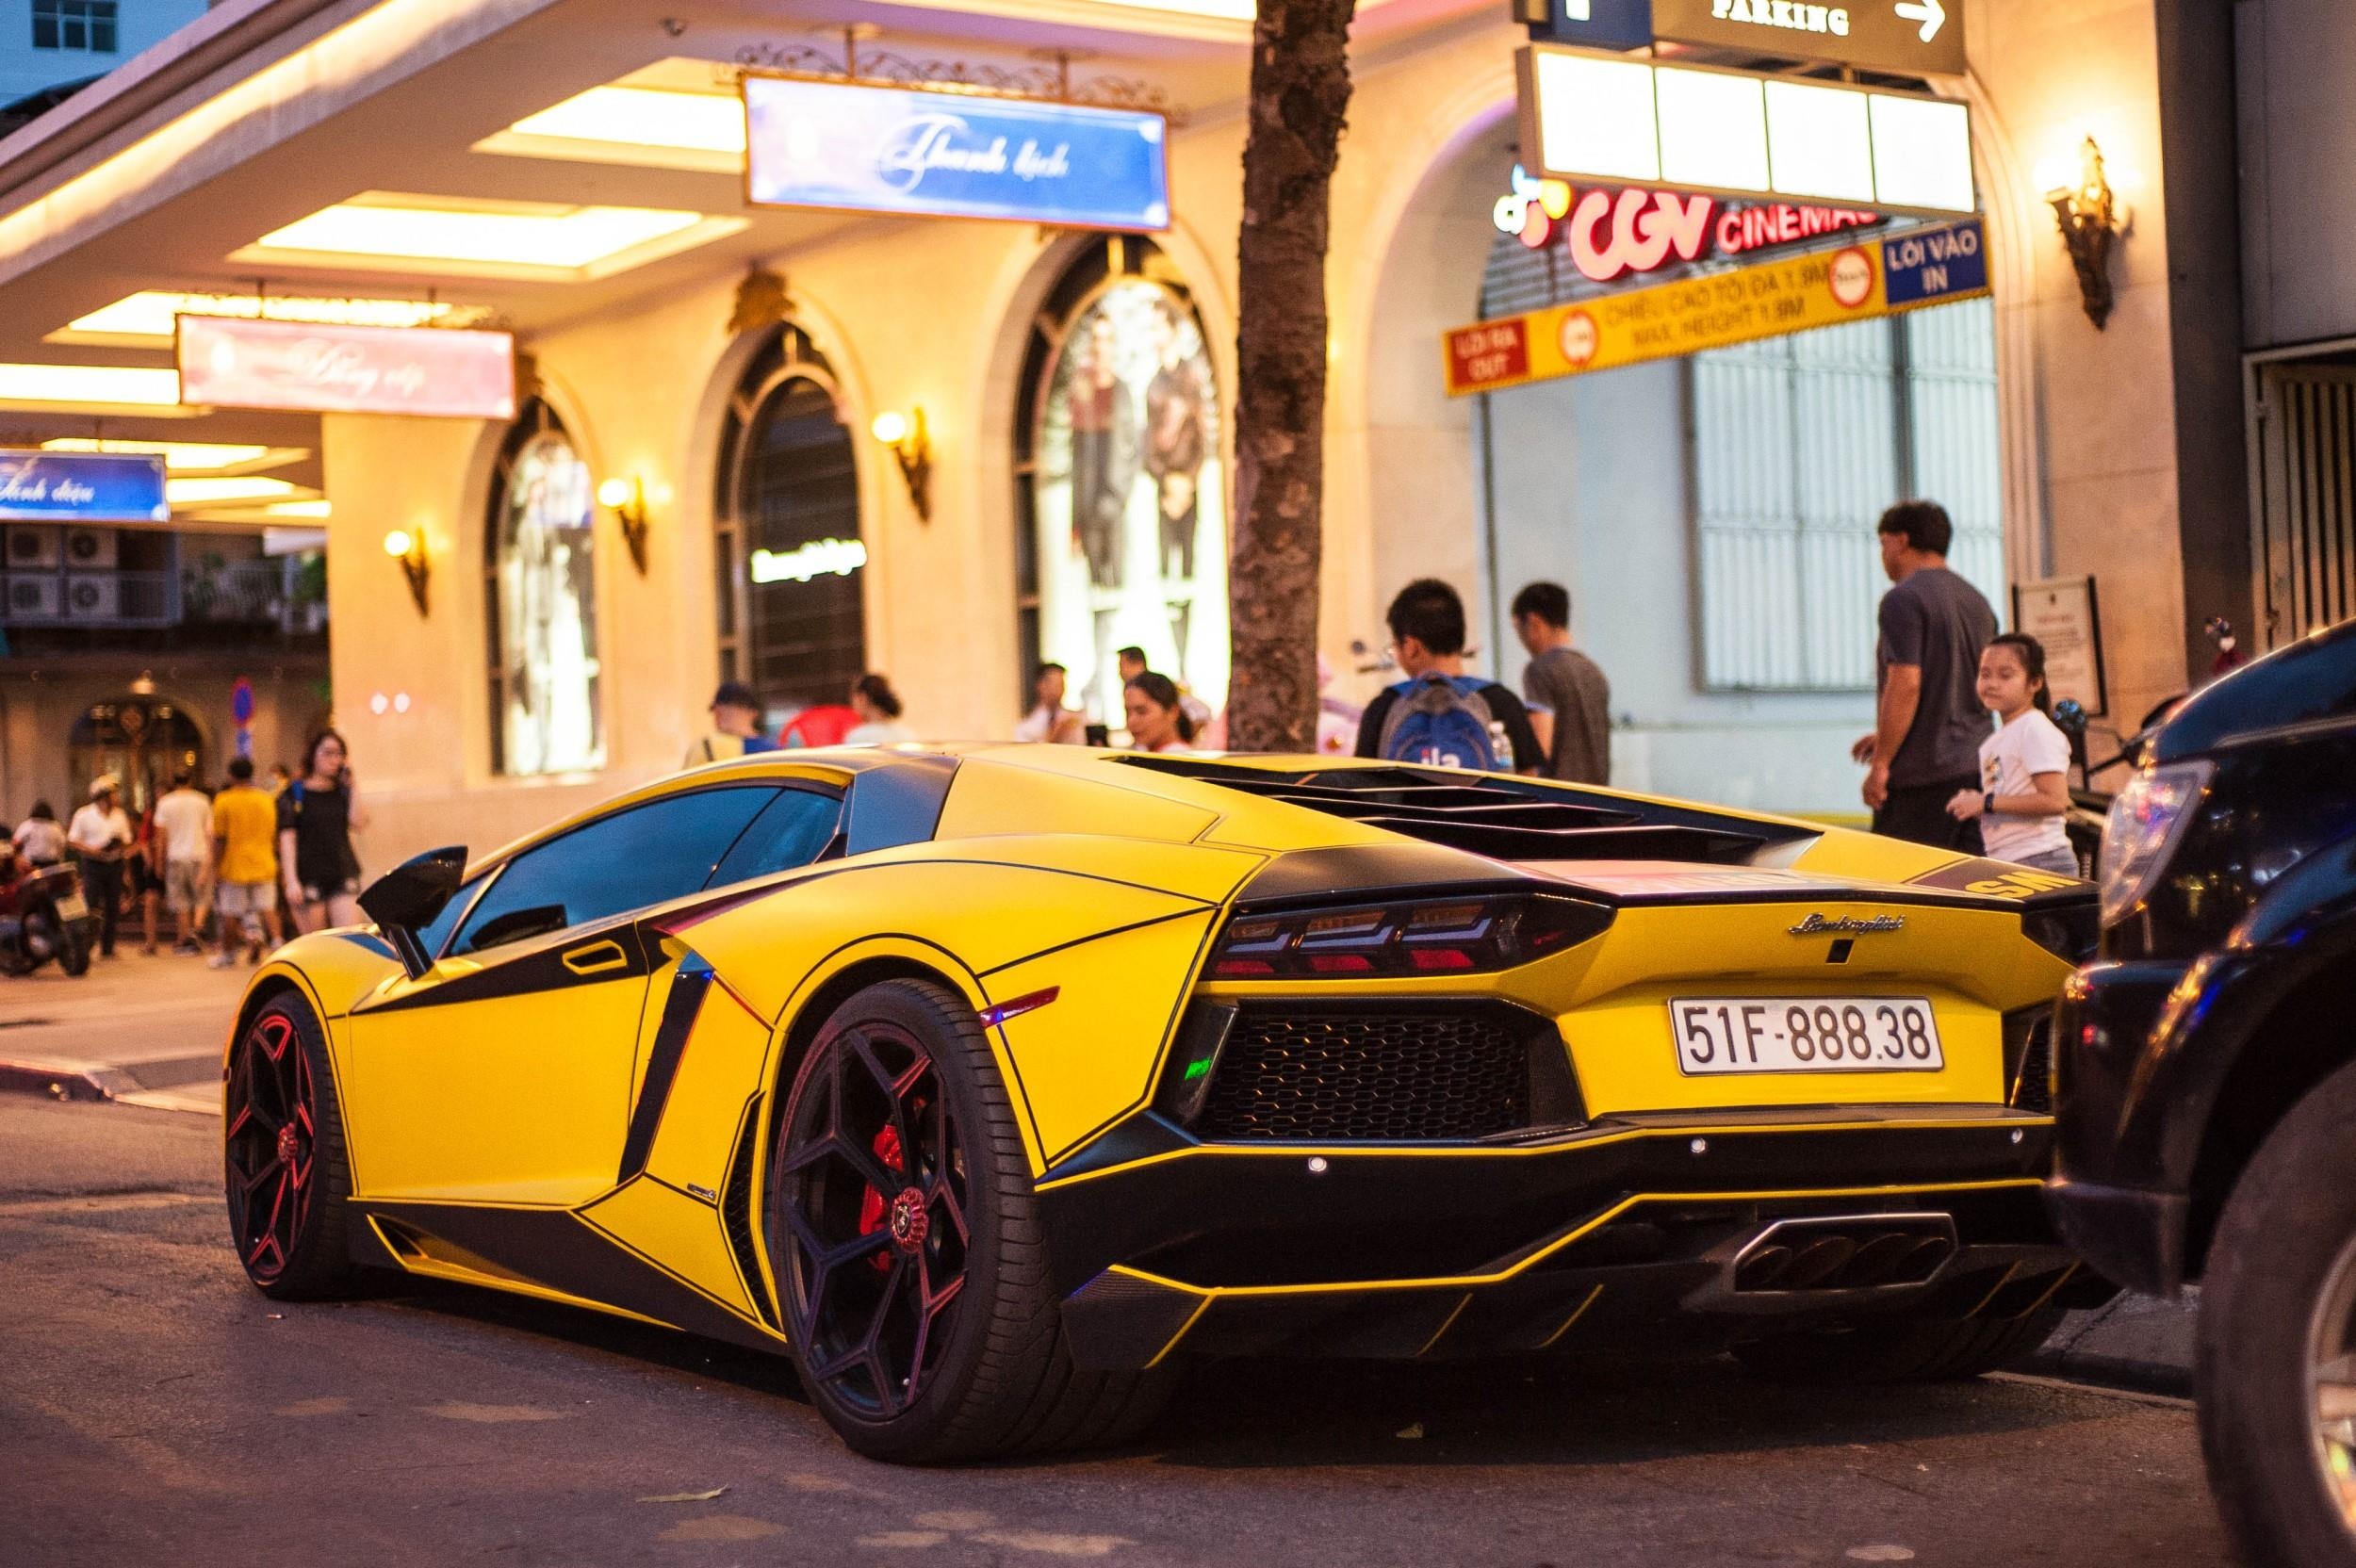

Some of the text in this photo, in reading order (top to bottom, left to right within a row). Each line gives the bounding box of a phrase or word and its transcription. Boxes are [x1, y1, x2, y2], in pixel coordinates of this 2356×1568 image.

[1711, 0, 1850, 37] PARKING
[1570, 188, 1714, 281] CGV
[1922, 264, 1948, 294] IN
[1788, 912, 1906, 935] Lamborghini
[1683, 1005, 1931, 1064] 51F-888.38
